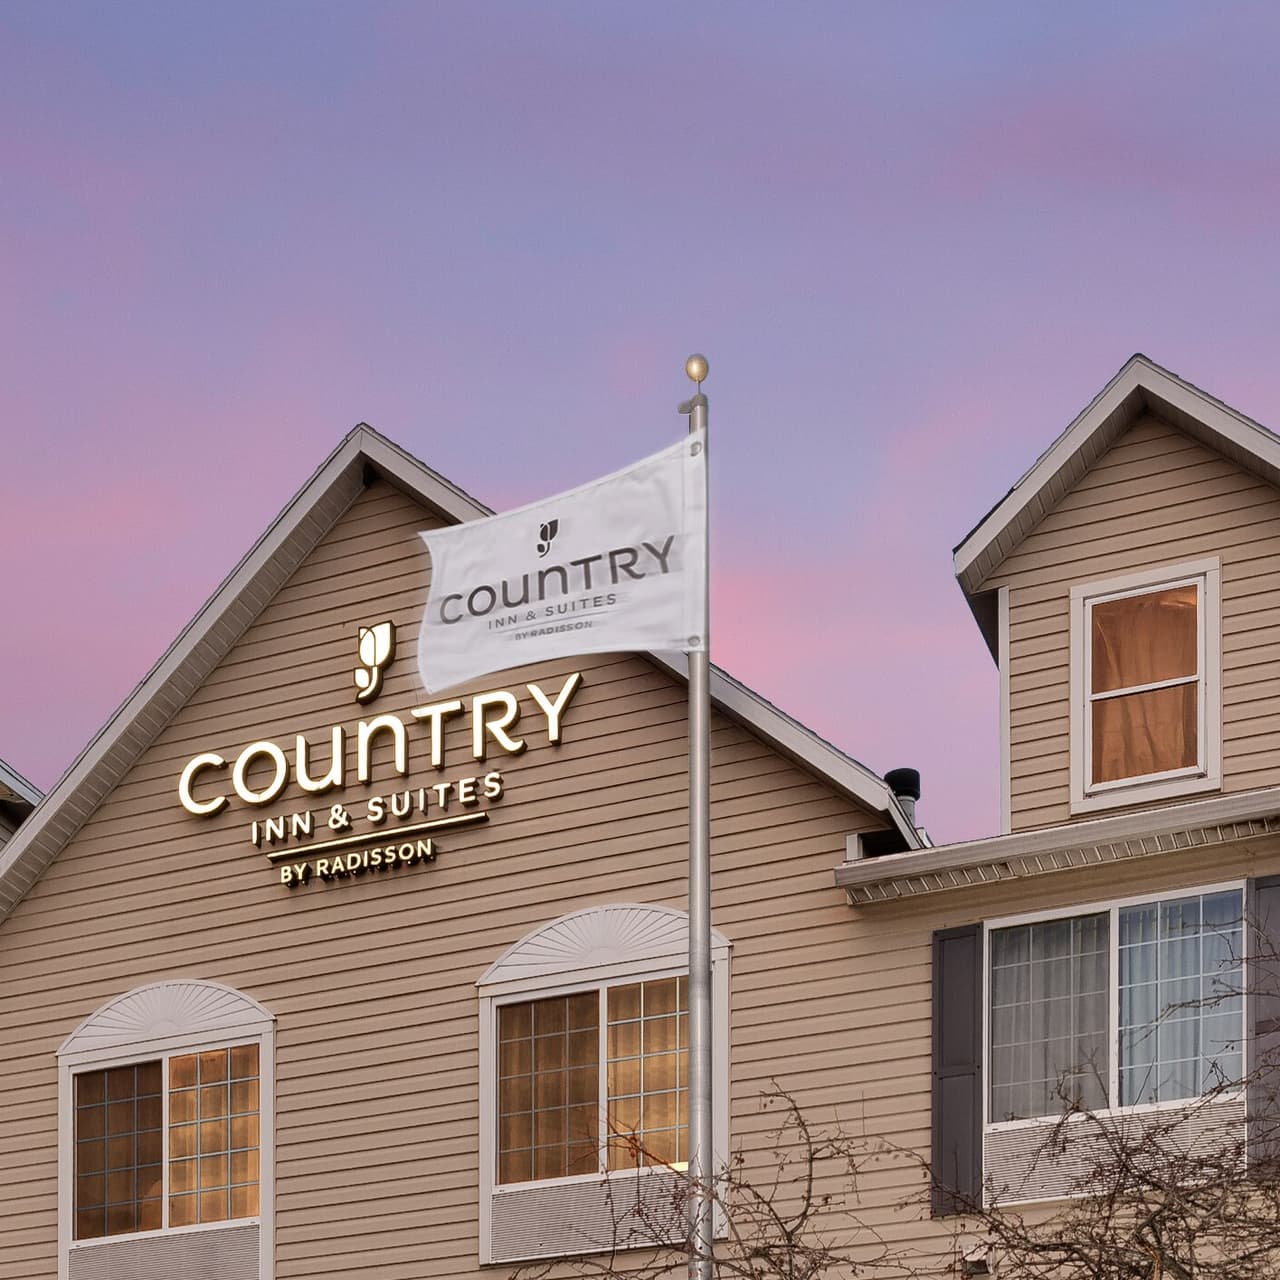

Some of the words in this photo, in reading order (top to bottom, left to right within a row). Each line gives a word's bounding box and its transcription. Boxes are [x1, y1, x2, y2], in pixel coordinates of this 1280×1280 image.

[488, 614, 521, 630] INN
[526, 609, 537, 621] &
[545, 593, 617, 616] SUITES
[514, 630, 527, 641] BY
[529, 620, 593, 637] RADISSON
[252, 810, 316, 847] INN
[328, 803, 354, 831] &
[366, 772, 505, 825] SUITES
[280, 862, 308, 886] BY
[316, 838, 434, 878] RADISSON
